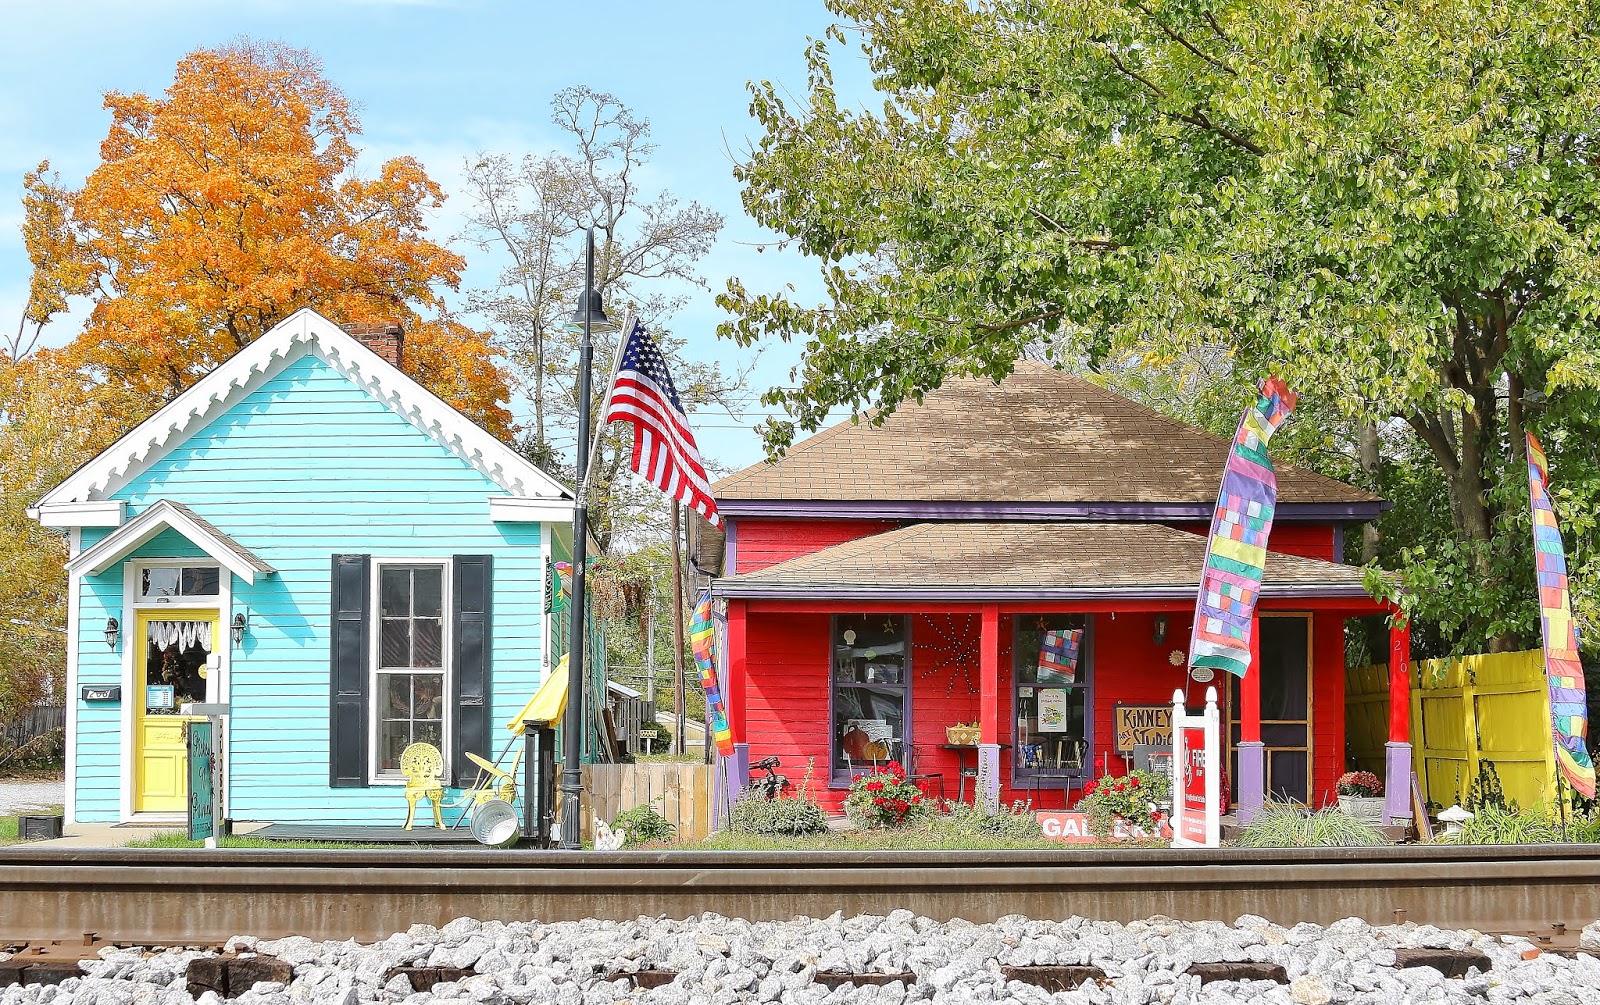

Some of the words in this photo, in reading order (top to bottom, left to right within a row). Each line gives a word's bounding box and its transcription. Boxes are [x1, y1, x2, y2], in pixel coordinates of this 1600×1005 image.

[545, 564, 553, 611] WELCOME
[1394, 640, 1407, 673] 210
[1042, 817, 1166, 838] GALERY
